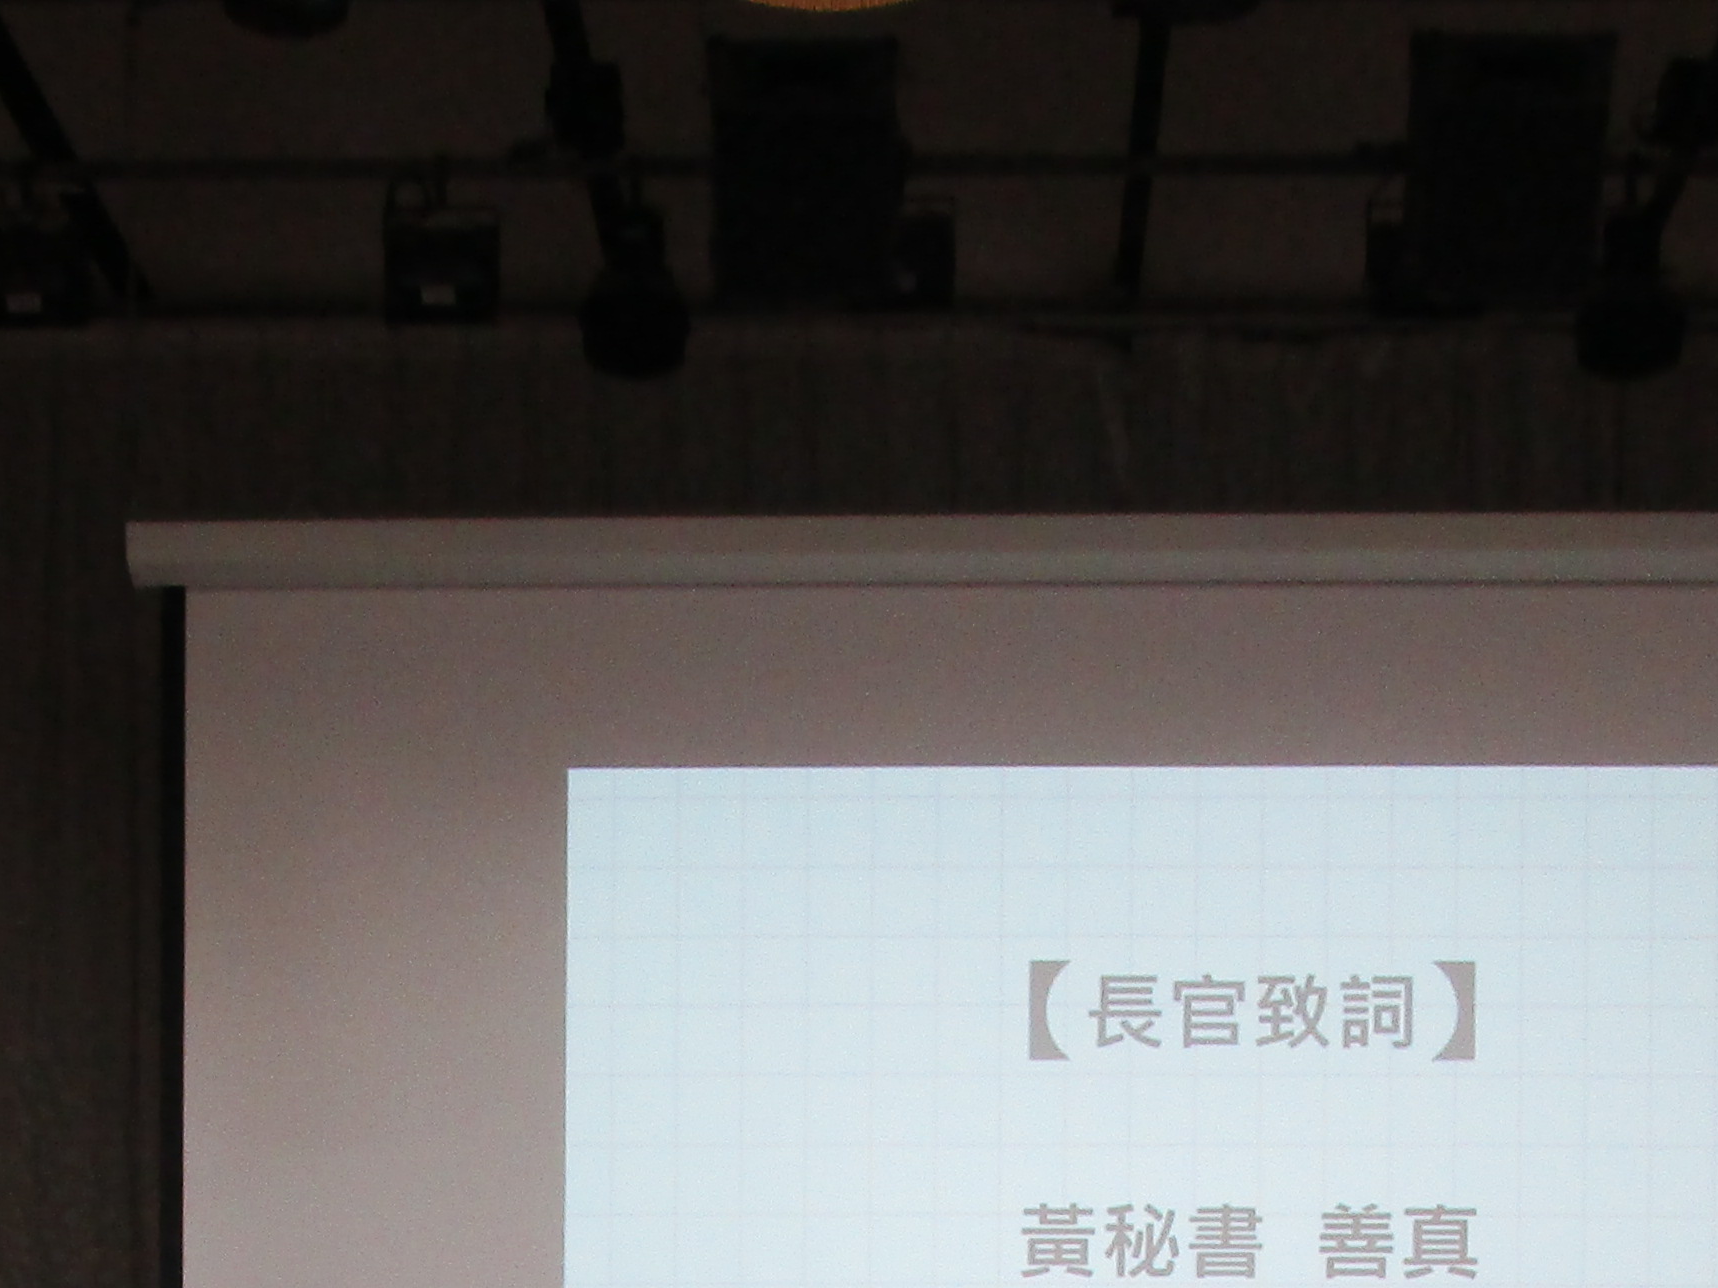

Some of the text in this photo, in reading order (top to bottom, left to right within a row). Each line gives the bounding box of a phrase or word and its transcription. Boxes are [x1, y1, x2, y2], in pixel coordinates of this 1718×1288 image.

[1028, 959, 1476, 1062] 【長官致詞】
[1021, 1202, 1478, 1279] 黃秘書 善真
